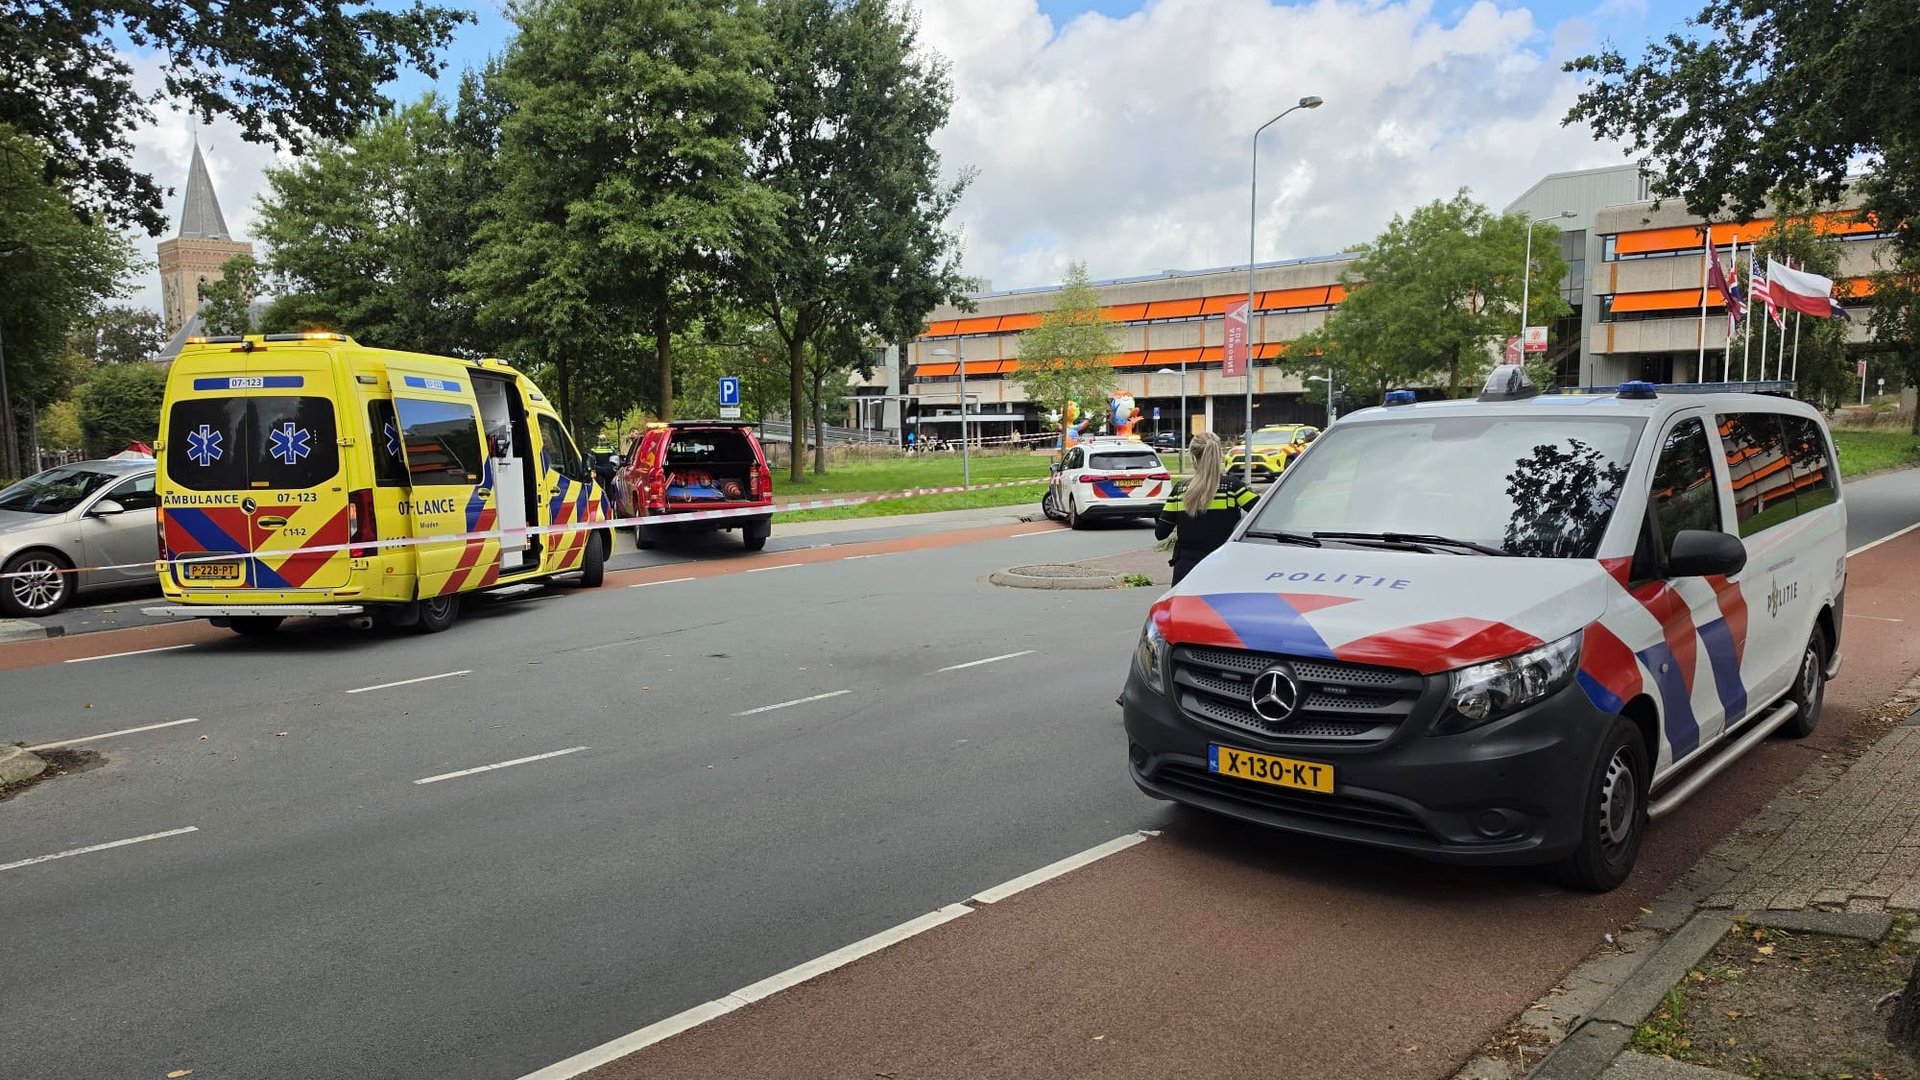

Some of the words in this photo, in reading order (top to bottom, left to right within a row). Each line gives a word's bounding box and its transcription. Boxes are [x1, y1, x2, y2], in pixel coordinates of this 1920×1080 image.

[231, 378, 262, 387] 07-123
[723, 381, 734, 402] P
[164, 494, 239, 505] AMBULANCE
[277, 493, 317, 503] 07-123
[192, 564, 234, 575] P-228-PT
[1265, 572, 1411, 590] POLITIE
[1228, 752, 1322, 787] X-130-KT
